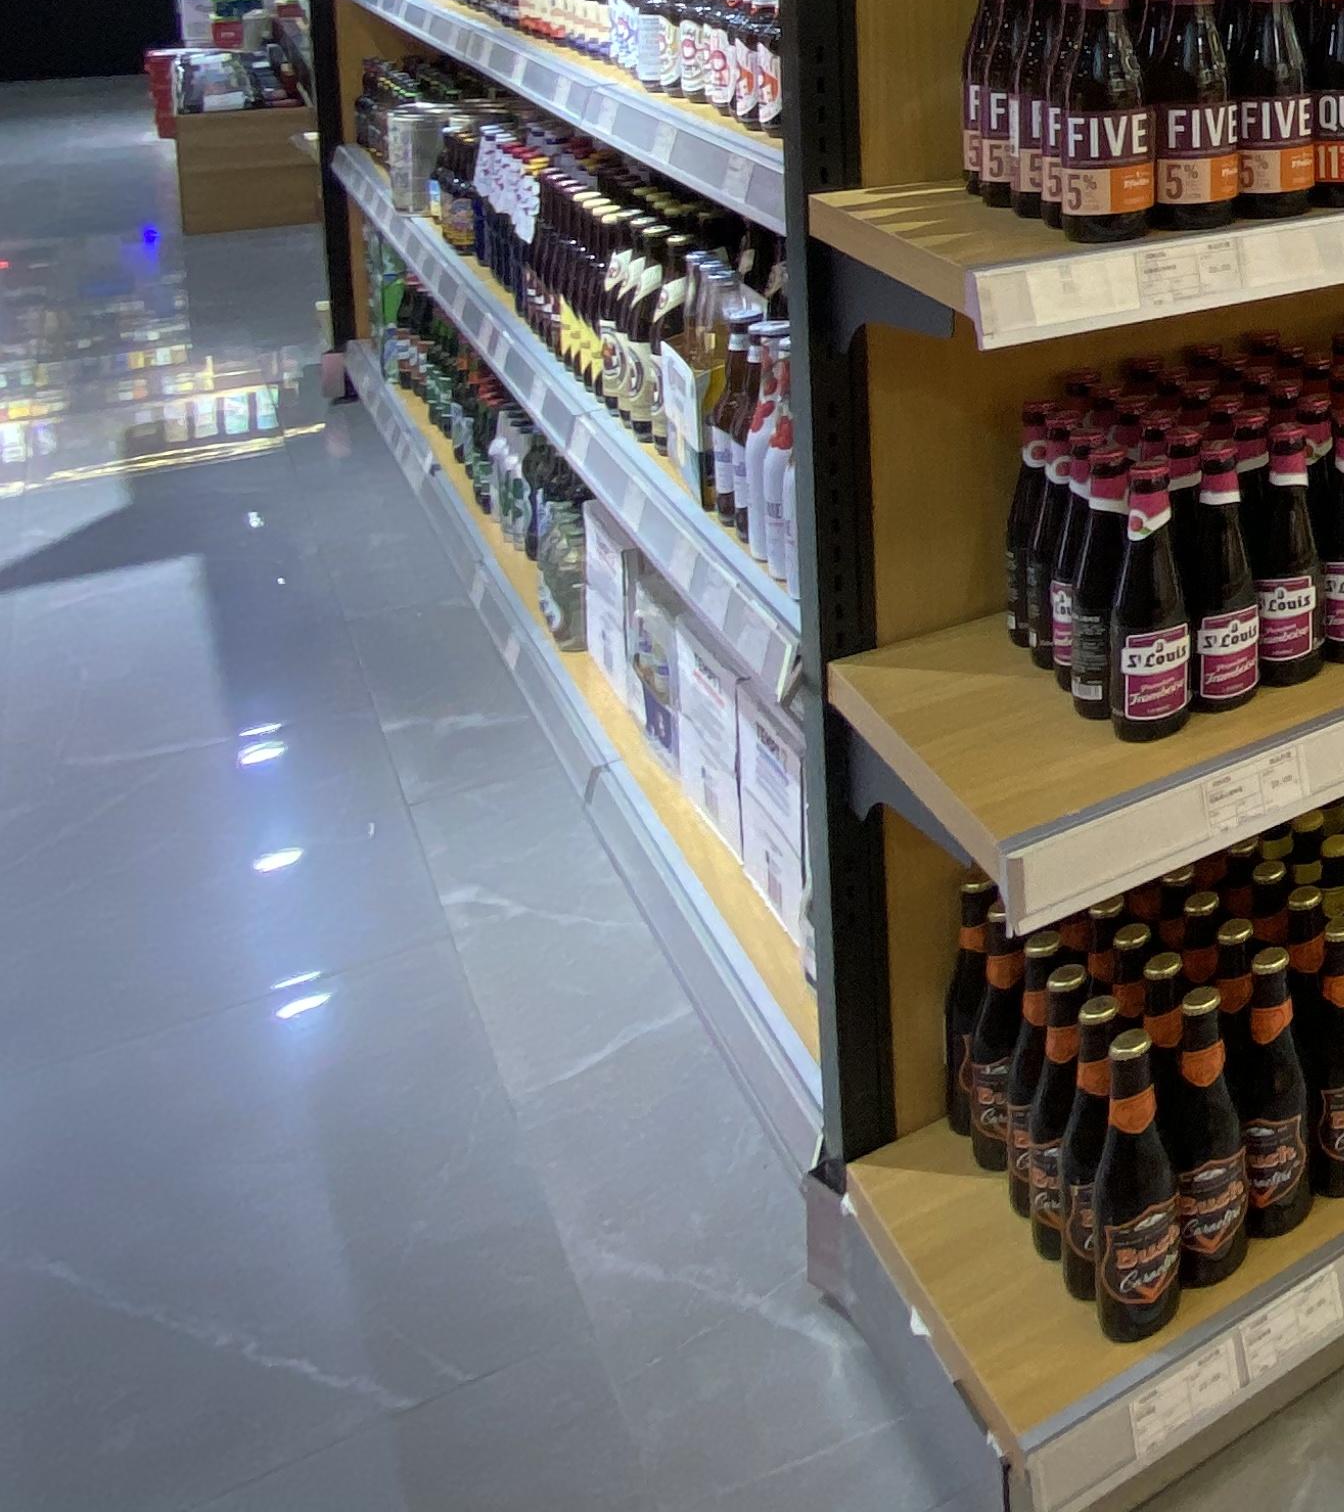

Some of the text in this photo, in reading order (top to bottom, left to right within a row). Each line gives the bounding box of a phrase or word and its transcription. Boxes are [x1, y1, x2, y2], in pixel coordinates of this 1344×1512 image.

[1067, 112, 1149, 159] FIVE
[1167, 104, 1239, 149] FIVE
[1240, 98, 1312, 140] FIVE
[1068, 174, 1097, 211] 5%
[1165, 164, 1199, 200] 5%
[1267, 594, 1312, 612] Louis
[1219, 624, 1257, 648] Louis
[1145, 645, 1187, 667] Louis
[1180, 1180, 1244, 1216] Bush
[1116, 1225, 1180, 1270] Bush
